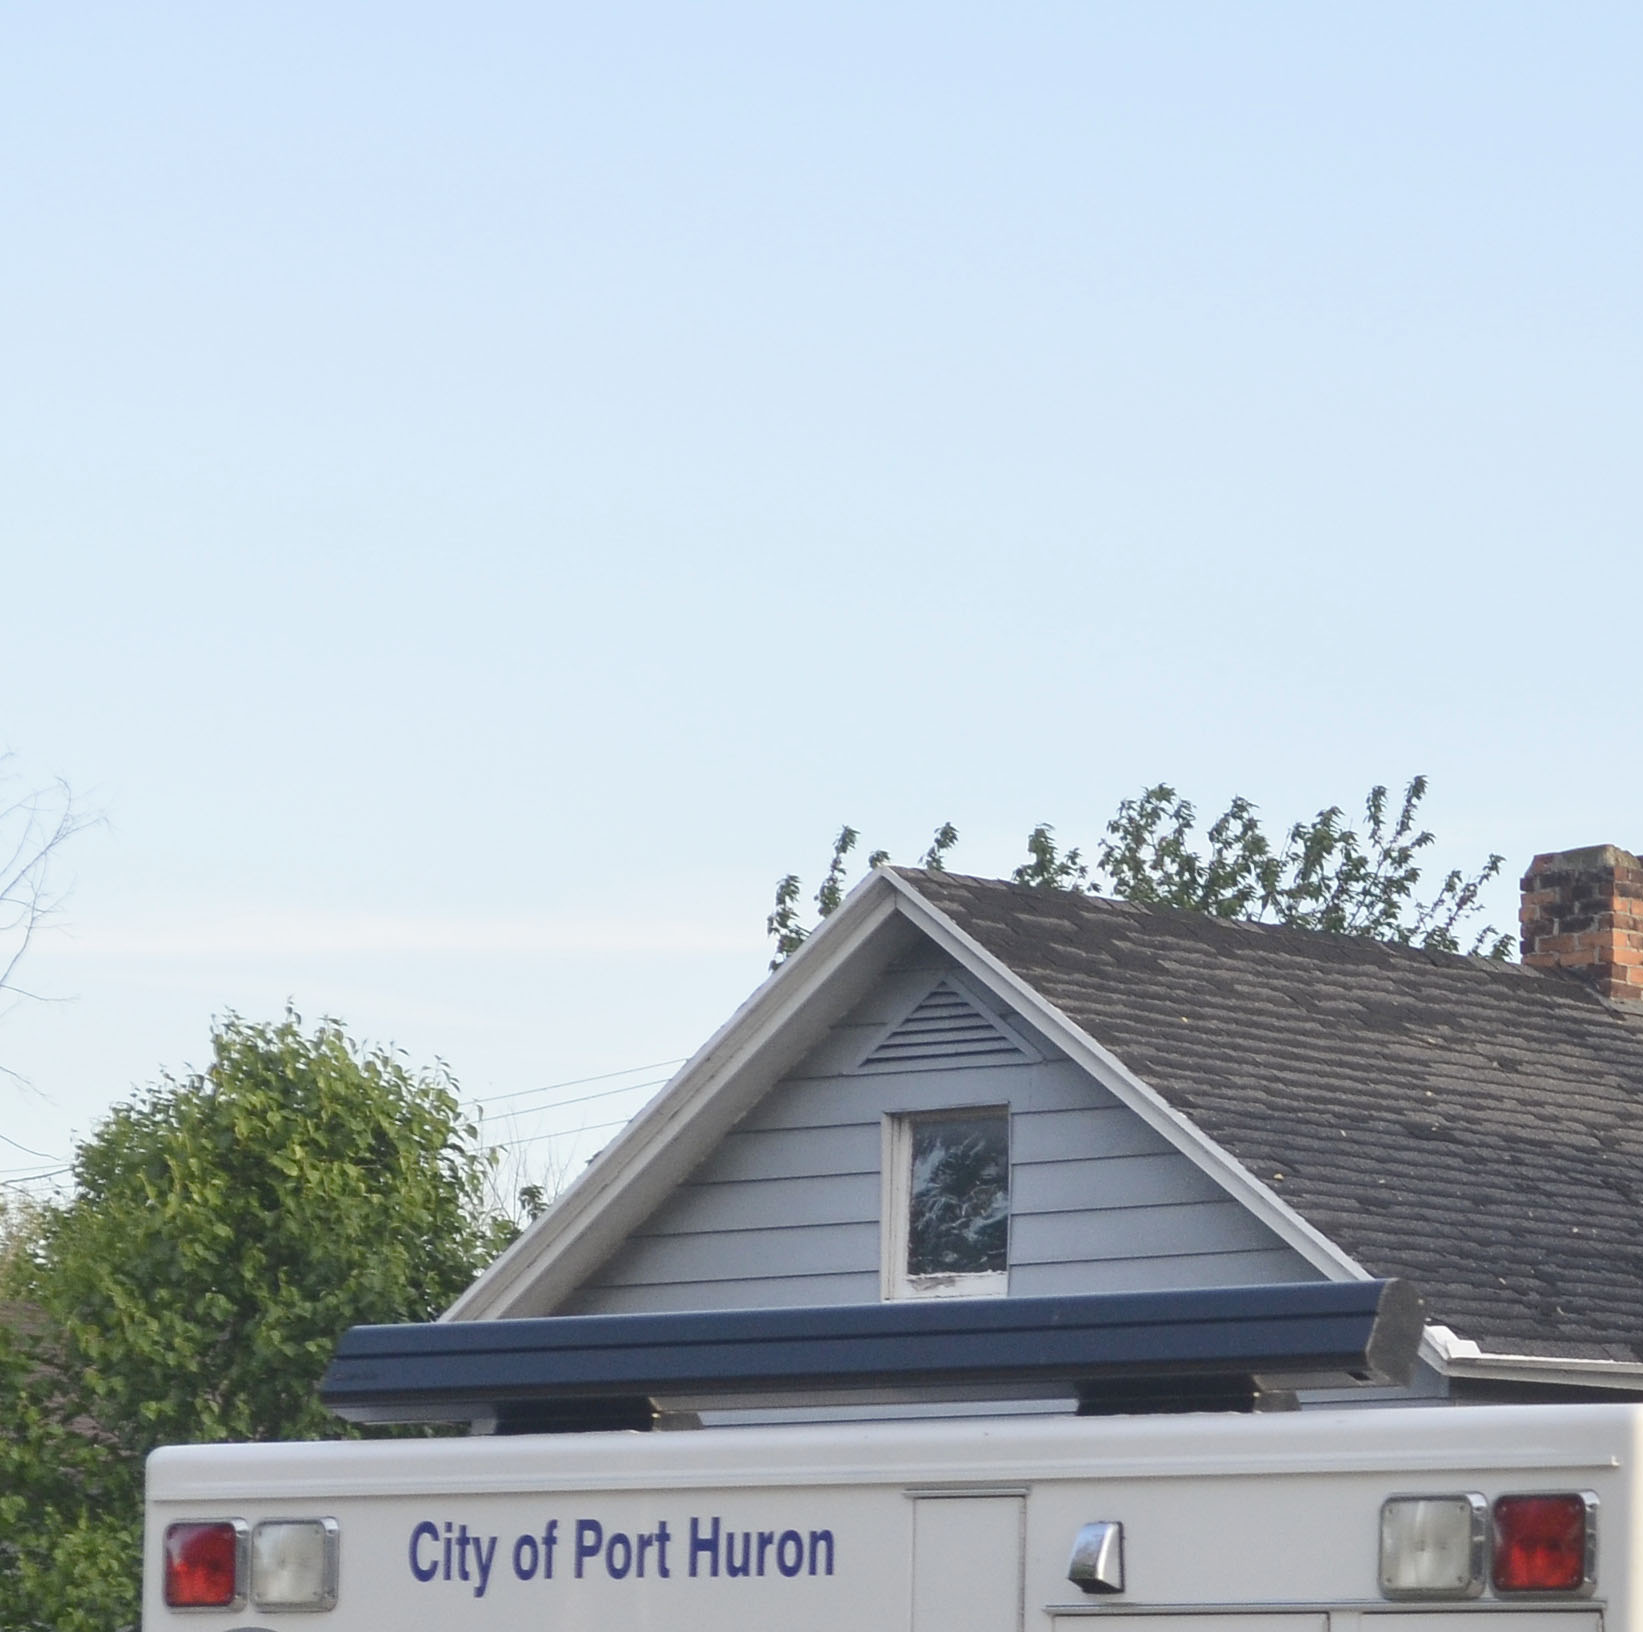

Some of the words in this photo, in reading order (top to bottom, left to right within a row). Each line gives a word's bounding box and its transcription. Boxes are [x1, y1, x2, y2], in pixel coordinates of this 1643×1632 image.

[409, 1519, 492, 1597] City
[513, 1518, 558, 1579] of
[575, 1518, 670, 1579] Port
[689, 1516, 835, 1577] Huron
